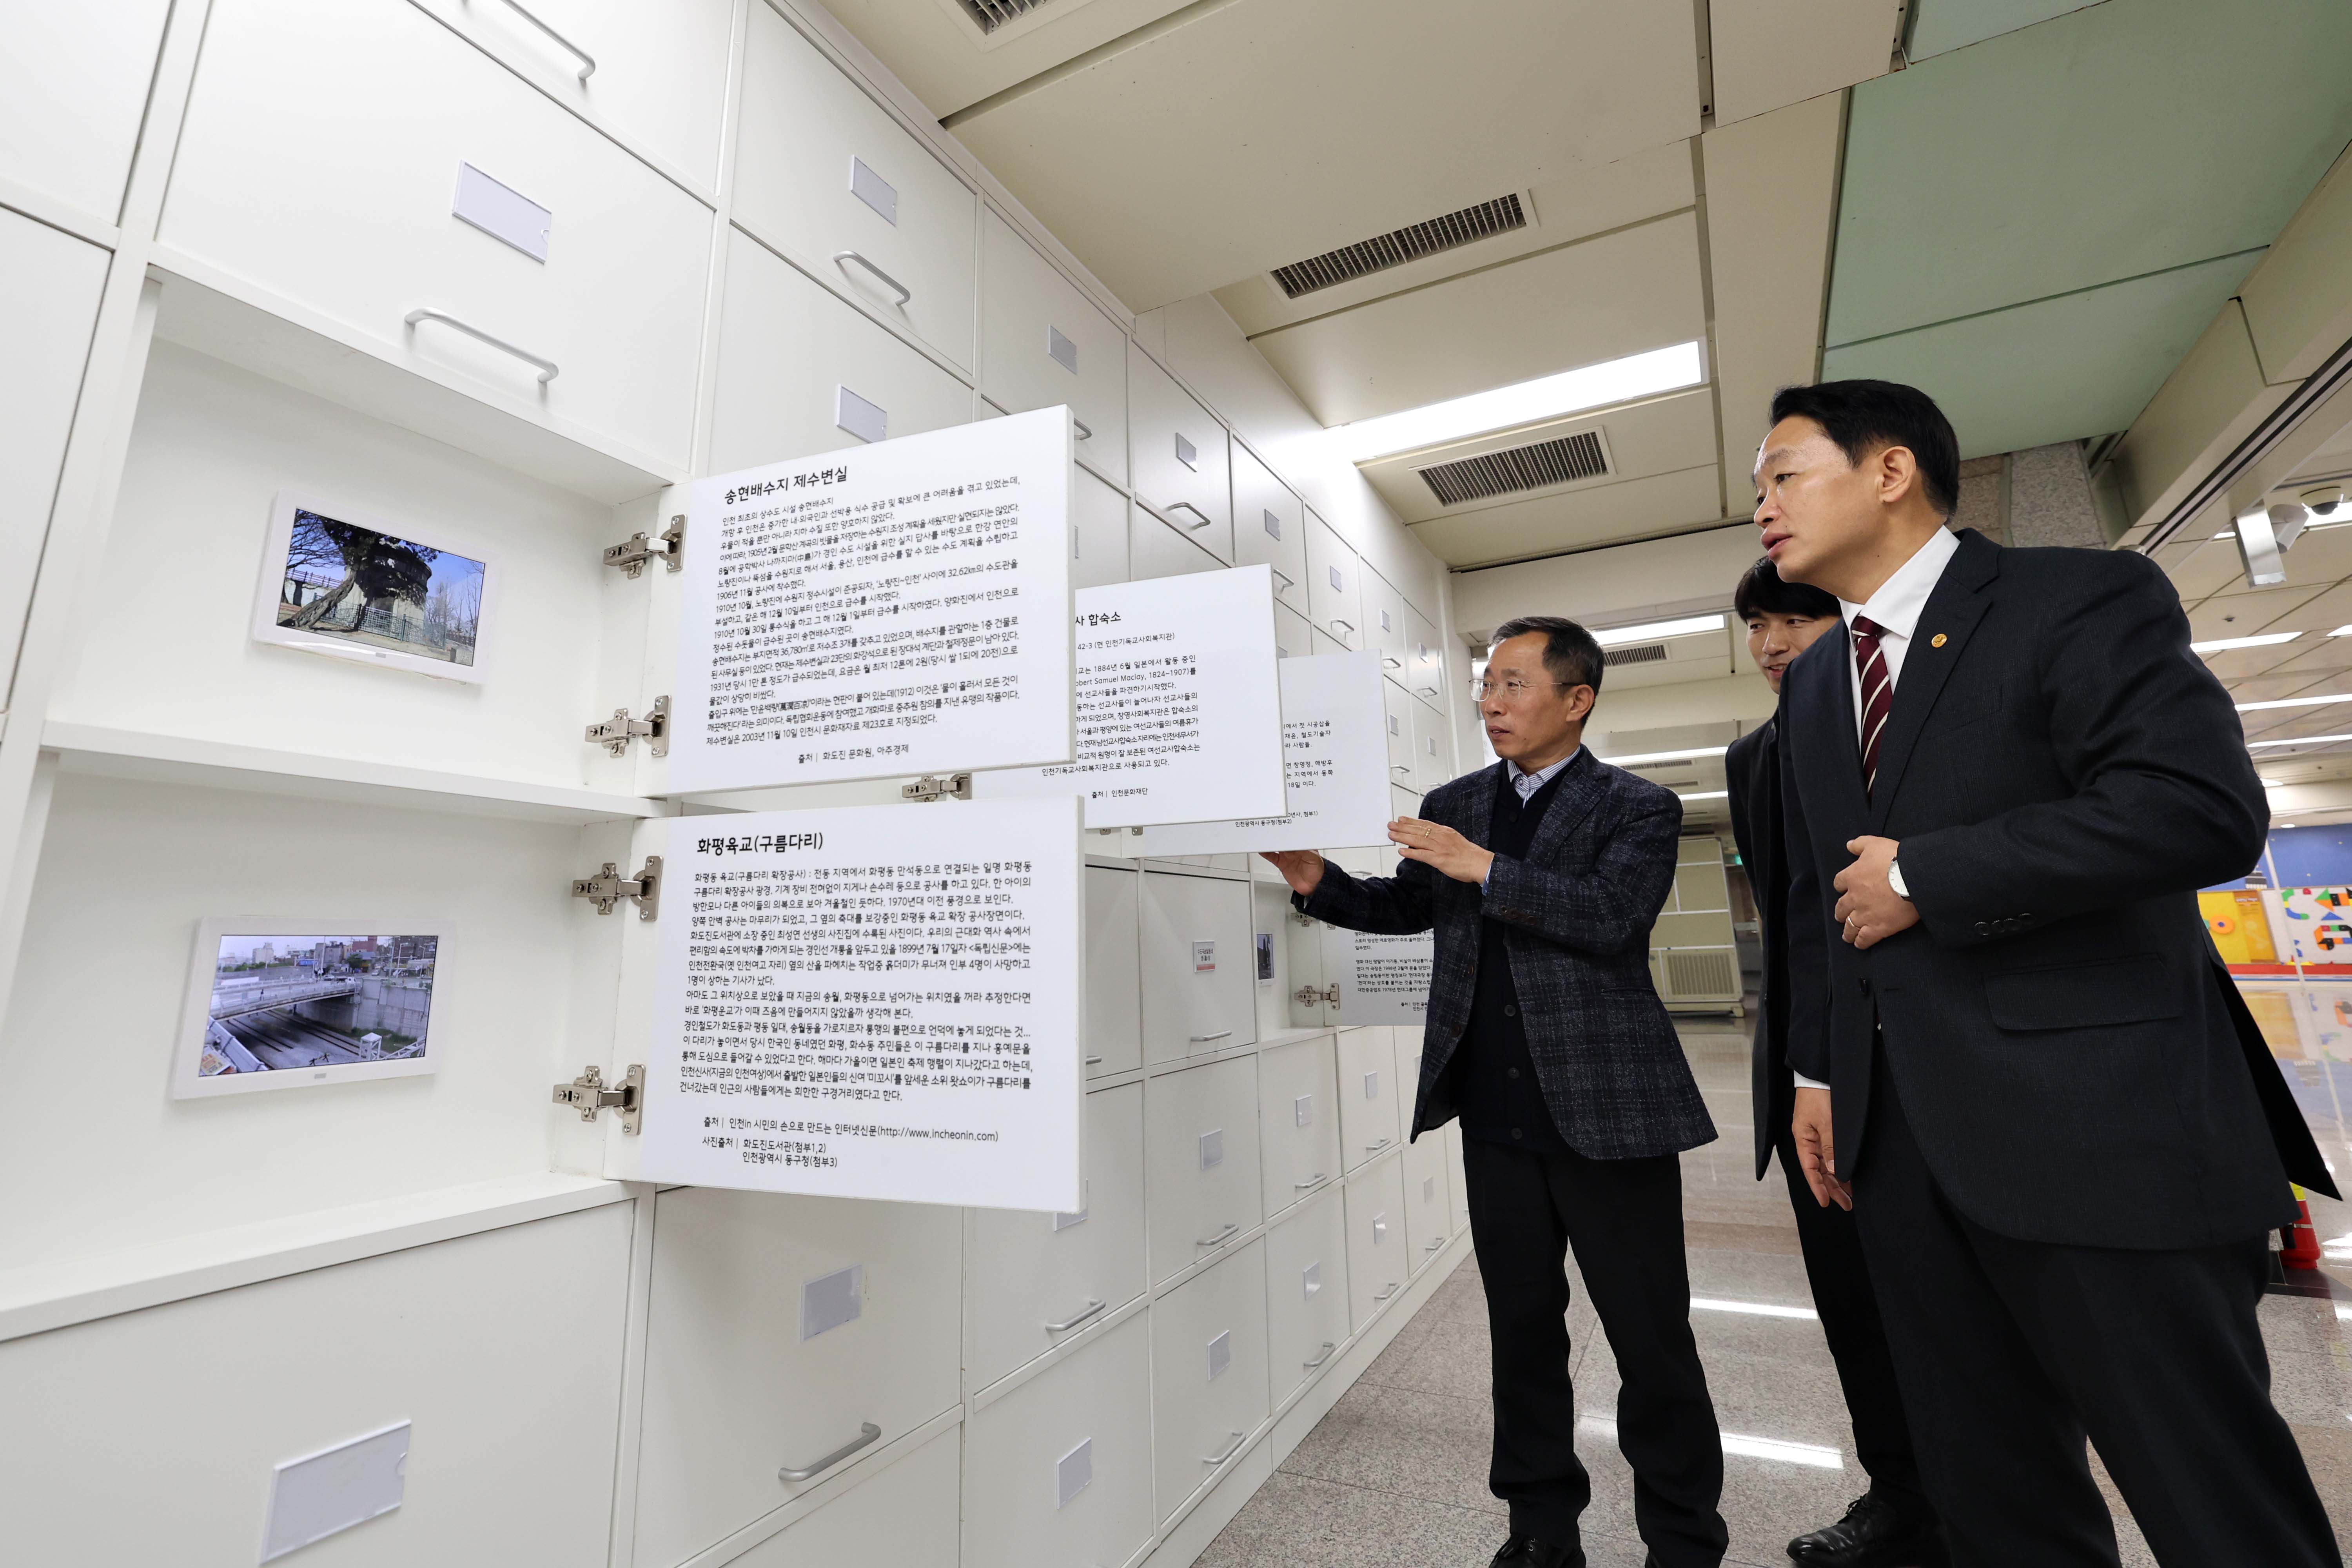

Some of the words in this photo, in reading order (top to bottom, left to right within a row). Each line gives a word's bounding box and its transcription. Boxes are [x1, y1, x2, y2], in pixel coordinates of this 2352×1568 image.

[724, 477, 789, 505] 송현배수지
[793, 465, 847, 488] 제수변실
[722, 516, 736, 526] 인천
[737, 512, 758, 522] 최초의
[760, 508, 780, 519] 상수도
[782, 505, 796, 514] 시설
[798, 497, 833, 512] 송현배수지
[720, 539, 740, 550] 우물이
[741, 537, 755, 546] 적을
[756, 534, 770, 545] 뿐만
[771, 530, 792, 540] 아니라
[793, 527, 808, 536] 지하
[809, 524, 823, 534] 수질
[824, 522, 839, 531] 또한
[840, 516, 869, 530] 양호하지
[871, 512, 895, 524] 않았다.
[717, 590, 738, 600] 1906년
[740, 587, 753, 597] 11월
[754, 584, 775, 596] 공사에
[776, 579, 806, 592] 착수했다.
[1088, 611, 1122, 626] 합숙소
[1105, 632, 1175, 648] 인천기독교사회복지관)
[1094, 663, 1117, 672] 1884년
[1120, 662, 1131, 670] 6월
[1134, 658, 1161, 669] 일본에서
[1164, 657, 1179, 666] 활동
[1181, 654, 1196, 664] 중인
[1094, 675, 1118, 684] Samuel
[1121, 673, 1147, 682] Maclay,
[1149, 667, 1196, 679] 1824~1907)를
[709, 695, 730, 706] 물값이
[731, 692, 751, 704] 상당히
[753, 690, 775, 700] 비쌌다.
[1085, 688, 1118, 699] 선교사들을
[1120, 682, 1176, 694] 파견하기시작했다.
[1076, 703, 1096, 712] 동하는
[1098, 699, 1131, 710] 선교사들이
[1133, 696, 1161, 706] 늘어나자
[1163, 692, 1198, 703] 선교사들의
[1089, 713, 1116, 722] 되었으며,
[1117, 707, 1170, 720] 창영사회복지관은
[1171, 704, 1198, 715] 합숙소의
[706, 734, 740, 746] 제수변실은
[742, 731, 765, 742] 2003년
[767, 730, 780, 740] 11월
[783, 728, 797, 738] 10일
[799, 726, 821, 737] 인천시
[823, 722, 860, 735] 문화재자료
[862, 718, 894, 729] 제23호로
[896, 714, 937, 727] 지정되었다.
[1080, 726, 1099, 735] 서울과
[1100, 724, 1118, 734] 평양에
[1119, 724, 1132, 732] 있는
[1133, 720, 1171, 730] 여선교사들의
[1172, 717, 1199, 727] 여름휴가
[798, 753, 813, 764] 출처
[822, 750, 846, 760] 화도진
[848, 748, 874, 759] 문화원,
[877, 744, 909, 755] 아주경제
[1077, 751, 1096, 760] 비교적
[1097, 750, 1117, 759] 원형이
[1118, 749, 1125, 758] 잘
[1126, 748, 1146, 757] 보존된
[1147, 743, 1201, 755] 여선교사합숙소는
[1042, 762, 1122, 776] 인천기독교사회복지관으로
[1123, 760, 1152, 769] 사용되고
[1154, 759, 1170, 768] 있다.
[1111, 788, 1148, 797] 인천문화재단
[697, 832, 823, 857] 화평육교(구름다리)
[695, 873, 717, 883] 화평동
[719, 871, 768, 882] 육교(구름다리
[771, 869, 806, 881] 확장공사)
[814, 869, 830, 879] 전동
[833, 867, 866, 878] 지역에서
[869, 866, 895, 878] 화평동
[897, 864, 941, 877] 만석동으로
[944, 863, 980, 875] 연결되는
[983, 862, 1000, 874] 일명
[1004, 861, 1032, 873] 화평동
[688, 975, 706, 986] 1명이
[708, 975, 730, 986] 상하는
[732, 975, 755, 985] 기사가
[757, 975, 775, 986] 났다.
[685, 1005, 700, 1015] 바로
[745, 1006, 760, 1016] 이때
[762, 1006, 786, 1017] 즈음에
[788, 1007, 828, 1018] 만들어지지
[830, 1007, 864, 1019] 않았을까
[866, 1008, 891, 1019] 생각해
[893, 1008, 913, 1019] 본다.
[679, 1082, 717, 1093] 건너갔는데
[719, 1083, 742, 1095] 인근의
[744, 1084, 792, 1097] 사람들에게는
[794, 1086, 819, 1098] 희한한
[821, 1088, 880, 1100] 구경거리였다고
[883, 1090, 902, 1102] 한다.
[703, 1116, 719, 1127] 출처
[729, 1118, 751, 1129] 인천in
[753, 1120, 777, 1131] 시민의
[780, 1121, 805, 1132] 손으로
[807, 1122, 832, 1134] 만드는
[702, 1136, 733, 1148] 사진출처
[743, 1138, 826, 1154] 화도진도서관(첨부1,2)
[742, 1151, 782, 1165] 인천광역시
[785, 1154, 837, 1168] 동구청(첨부3)
